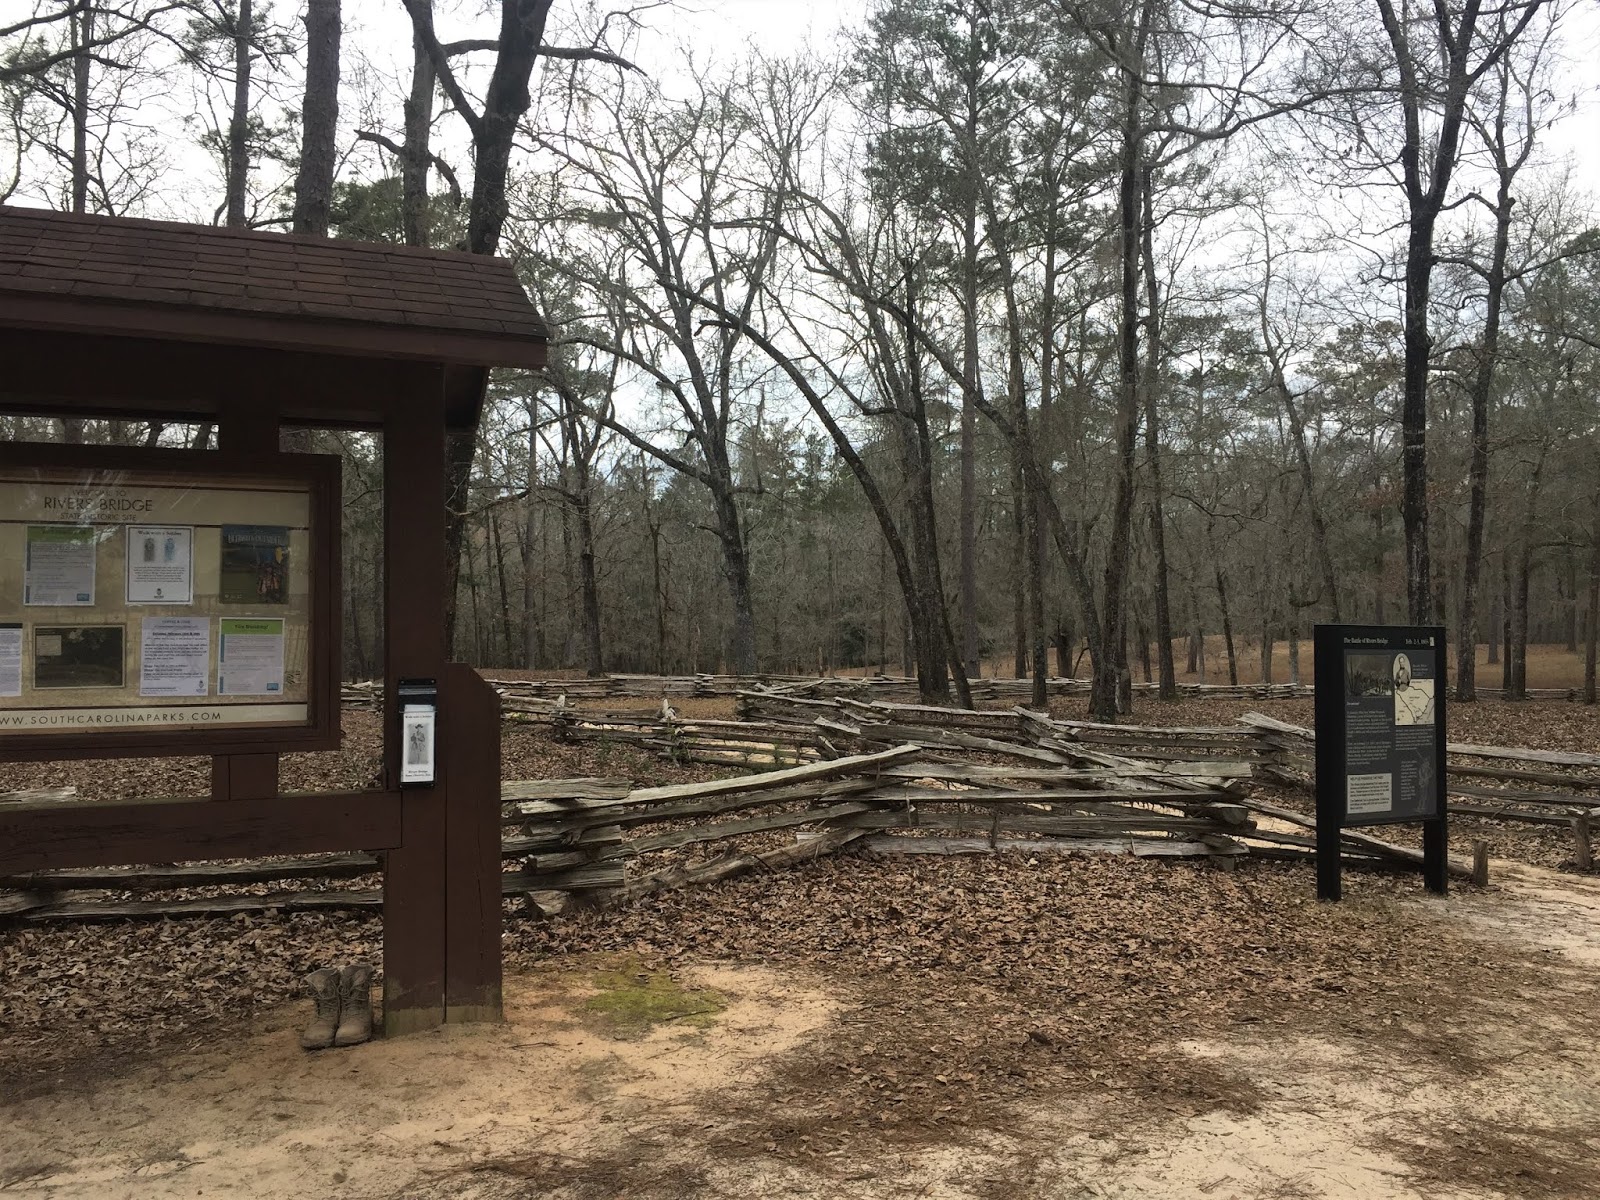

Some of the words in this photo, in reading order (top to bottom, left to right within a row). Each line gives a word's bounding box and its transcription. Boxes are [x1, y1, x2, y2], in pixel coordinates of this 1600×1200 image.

[44, 496, 92, 510] RIVERS
[99, 498, 152, 511] BRIDGE
[1377, 637, 1389, 645] Bridge
